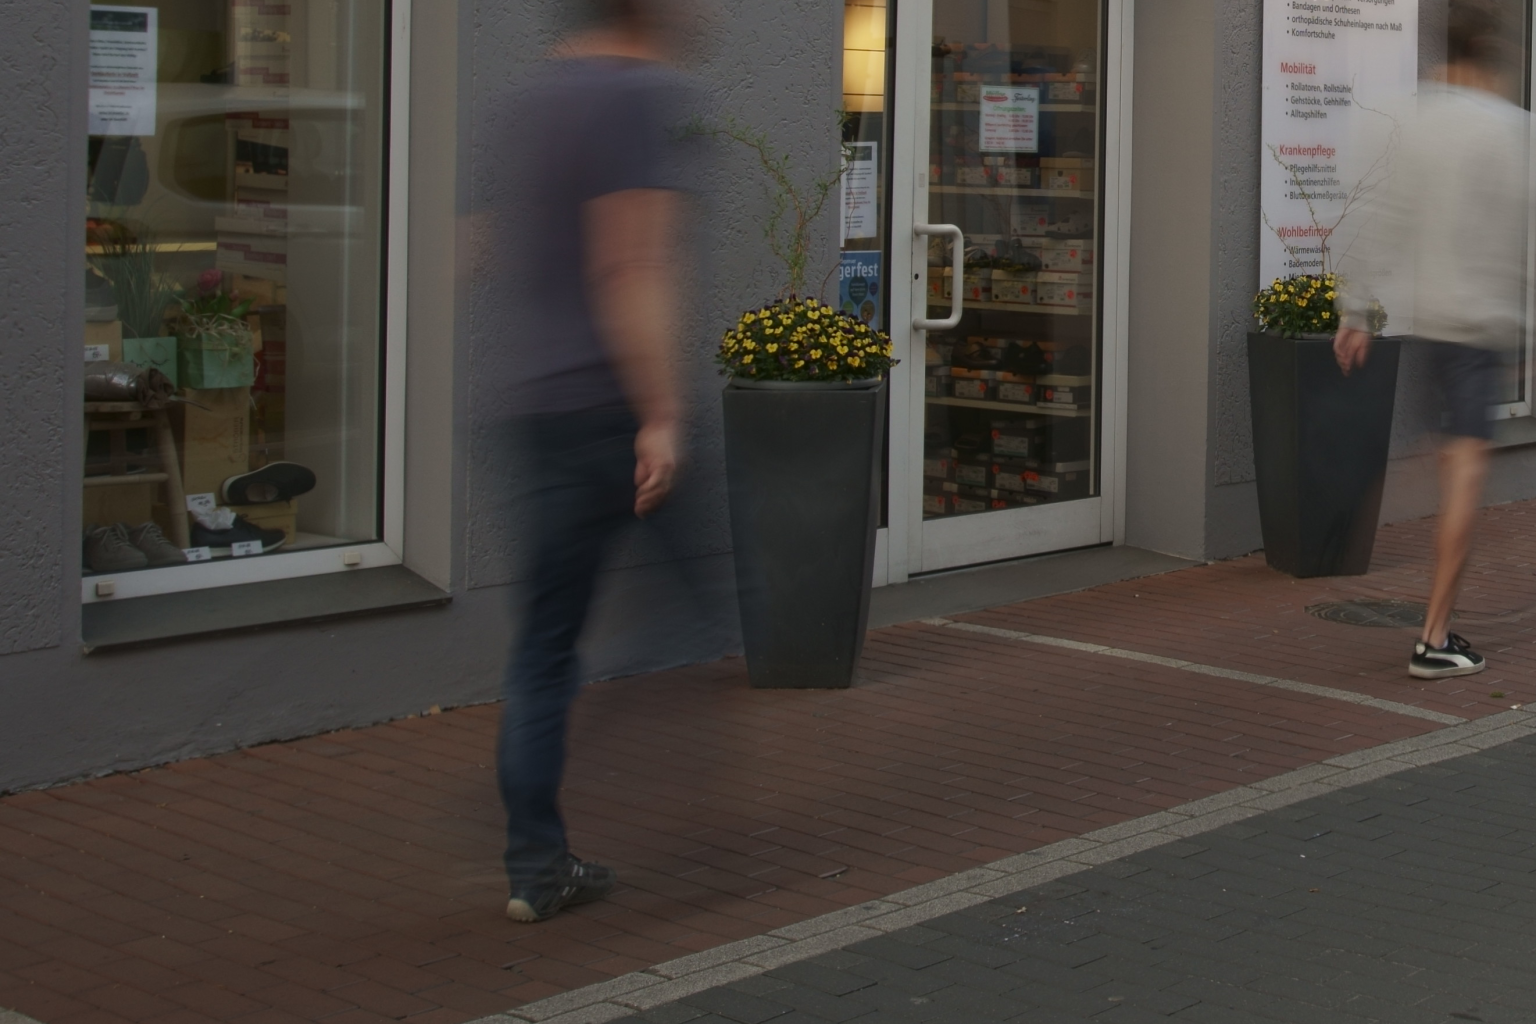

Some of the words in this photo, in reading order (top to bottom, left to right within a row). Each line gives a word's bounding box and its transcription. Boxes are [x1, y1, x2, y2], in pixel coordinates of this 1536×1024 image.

[1292, 1, 1321, 13] Bandagen
[1322, 4, 1334, 13] und
[1335, 5, 1361, 15] Orthesen
[1291, 15, 1333, 27] orthopädische
[1334, 18, 1374, 31] Schuheinlagen
[1375, 22, 1389, 31] nach
[1390, 23, 1403, 32] Maß
[1291, 28, 1336, 39] Komfortschuhe
[1280, 62, 1316, 75] Mobilität
[1290, 82, 1322, 93] Rollatoren,
[1323, 83, 1352, 94] Rollstühle
[1290, 96, 1322, 107] Gehstöcke,
[1323, 97, 1351, 107] Gehhilfen
[1290, 109, 1327, 120] Alltagshilfen
[1279, 144, 1336, 159] Krankenpflege
[1289, 164, 1337, 175] Pflegehilfsmittel
[1278, 225, 1333, 238] Wohlbefinden
[1288, 258, 1323, 268] Bademoden
